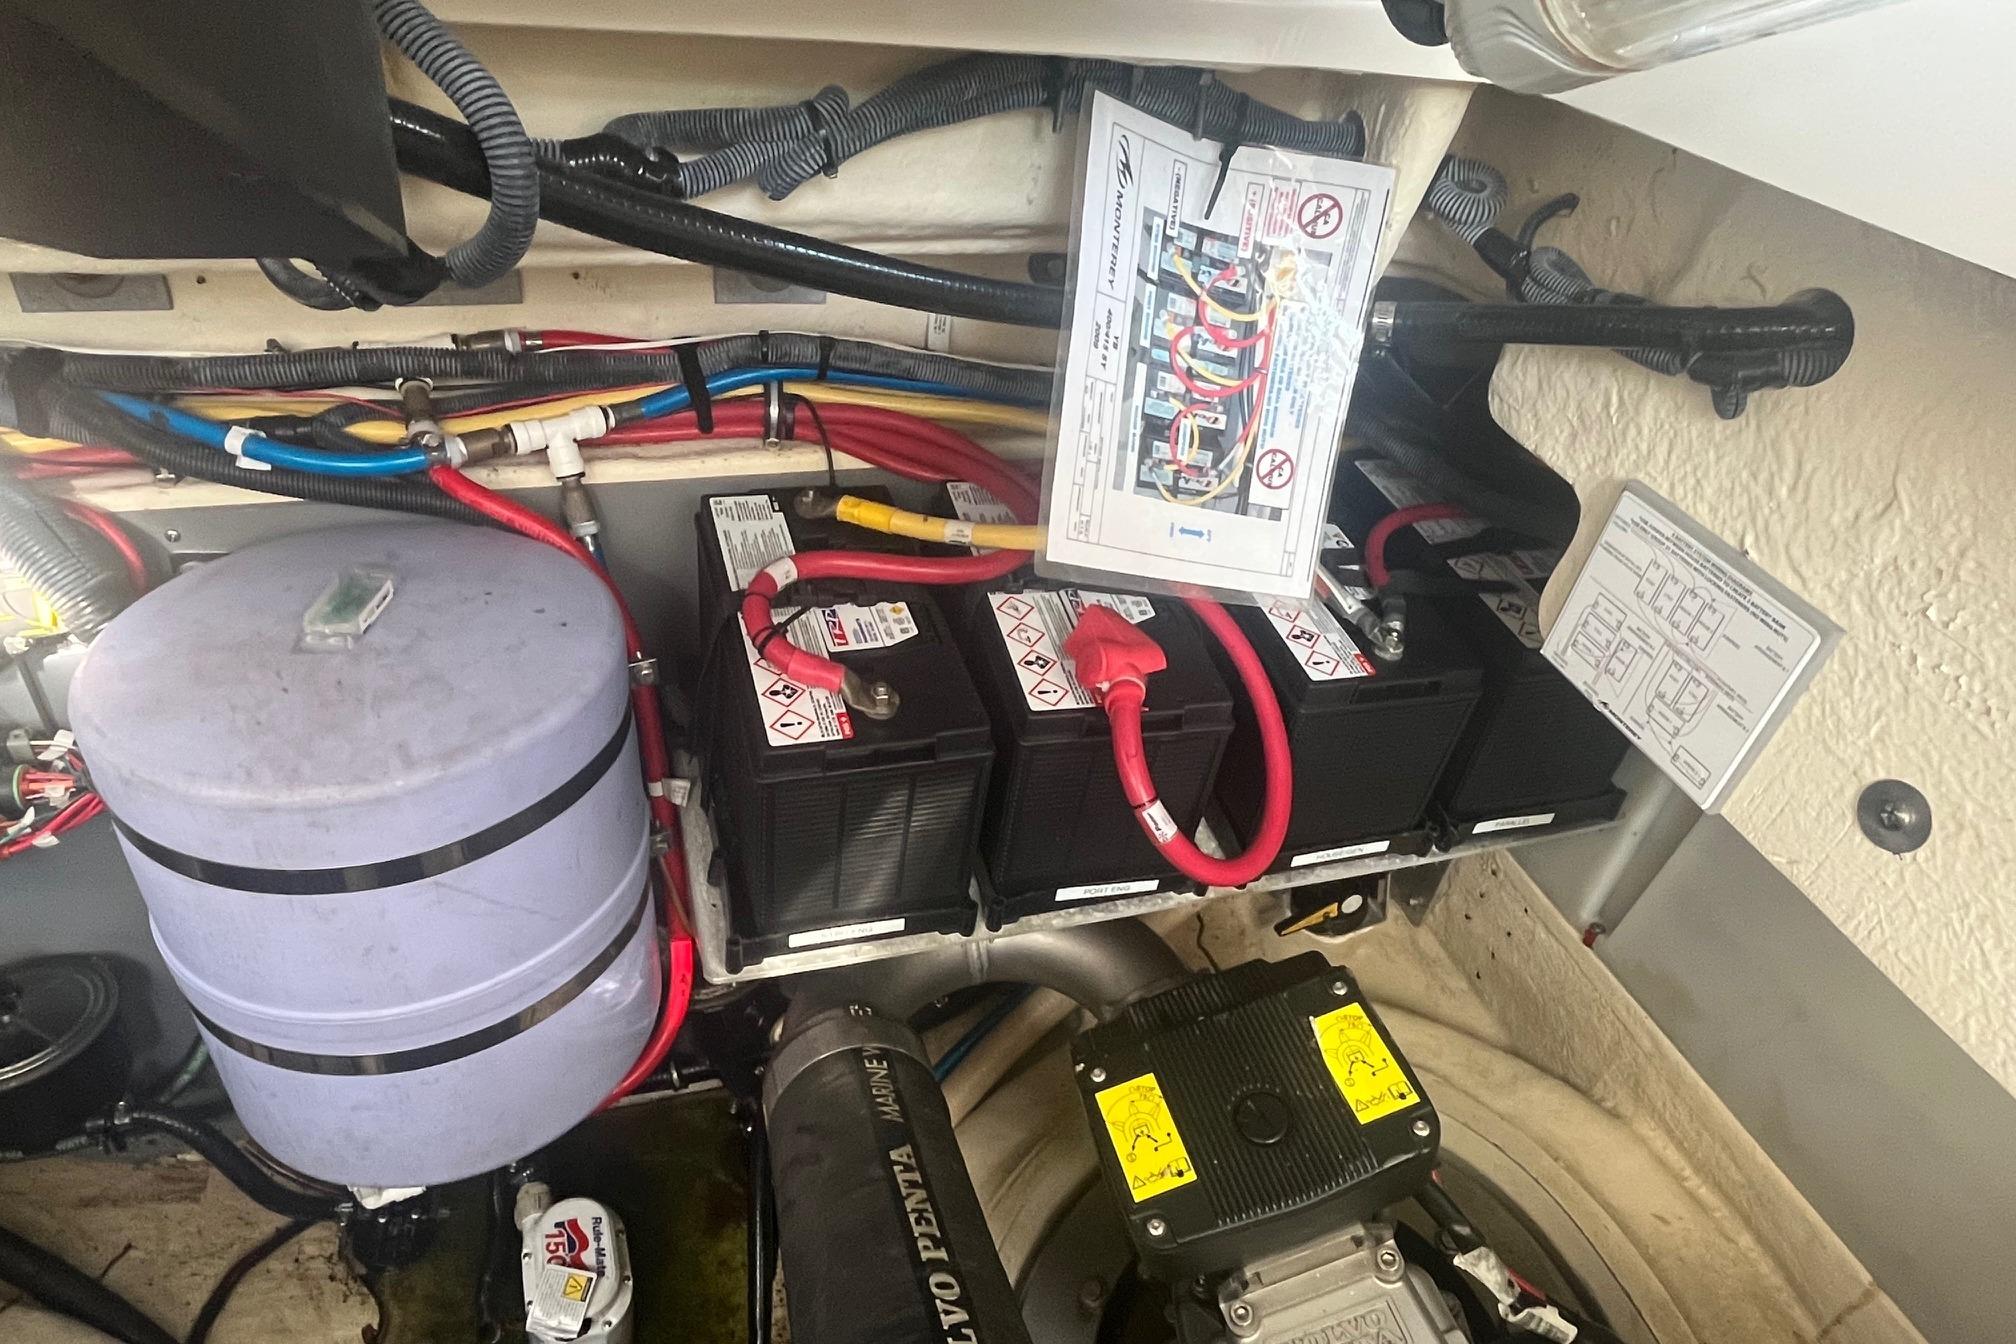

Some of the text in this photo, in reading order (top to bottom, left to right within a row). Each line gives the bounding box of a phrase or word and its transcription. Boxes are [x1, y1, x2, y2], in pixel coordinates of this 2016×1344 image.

[1168, 172, 1181, 230] (NEGATIVE)
[1240, 199, 1256, 252] (PSITIVE)
[1107, 189, 1124, 290] MONTEREY
[1093, 321, 1101, 349] 2009
[1608, 709, 1642, 741] MONTEREY
[1082, 884, 1130, 895] PORT ENG
[865, 1057, 905, 1123] MARINE
[889, 1144, 950, 1262] PENTA
[592, 1216, 607, 1277] Rule-Mate
